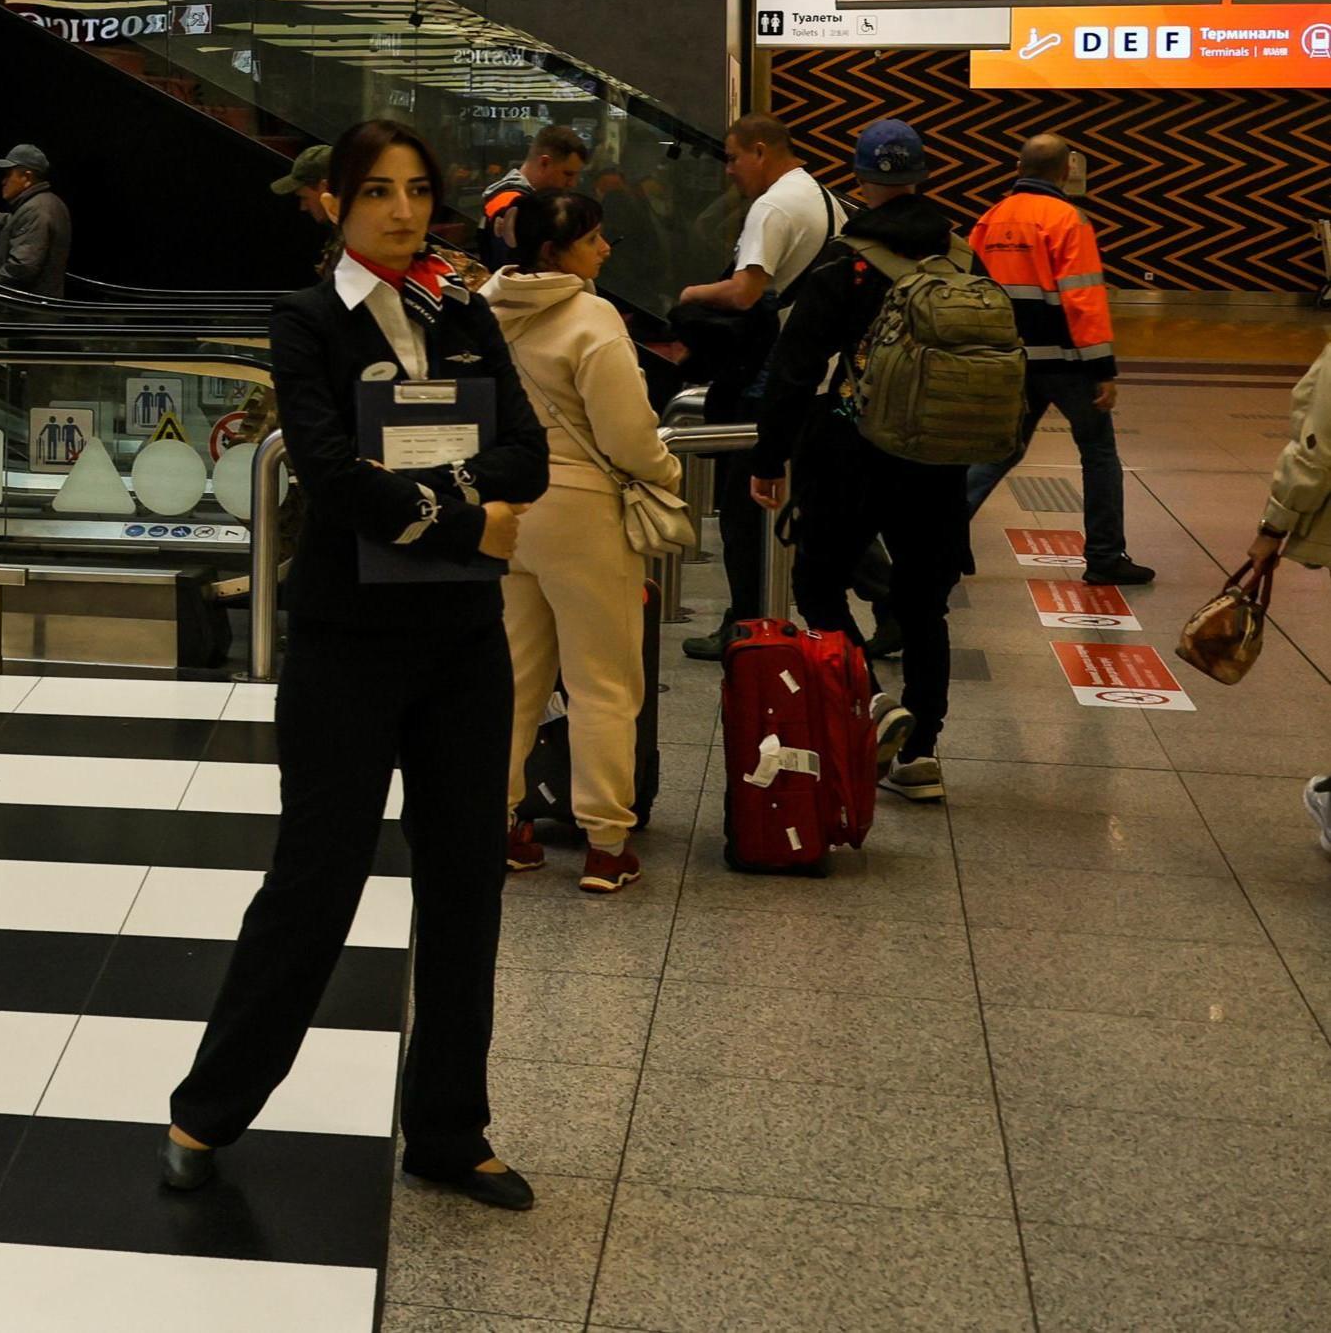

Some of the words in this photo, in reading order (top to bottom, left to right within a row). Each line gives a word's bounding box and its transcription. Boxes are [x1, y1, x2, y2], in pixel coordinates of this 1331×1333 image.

[792, 13, 843, 24] Туалеты
[792, 28, 819, 36] Toilets
[1199, 27, 1289, 41] Терминалы
[1083, 32, 1102, 52] D
[1124, 32, 1138, 52] E
[1166, 32, 1179, 52] F
[1199, 46, 1249, 57] Terminals
